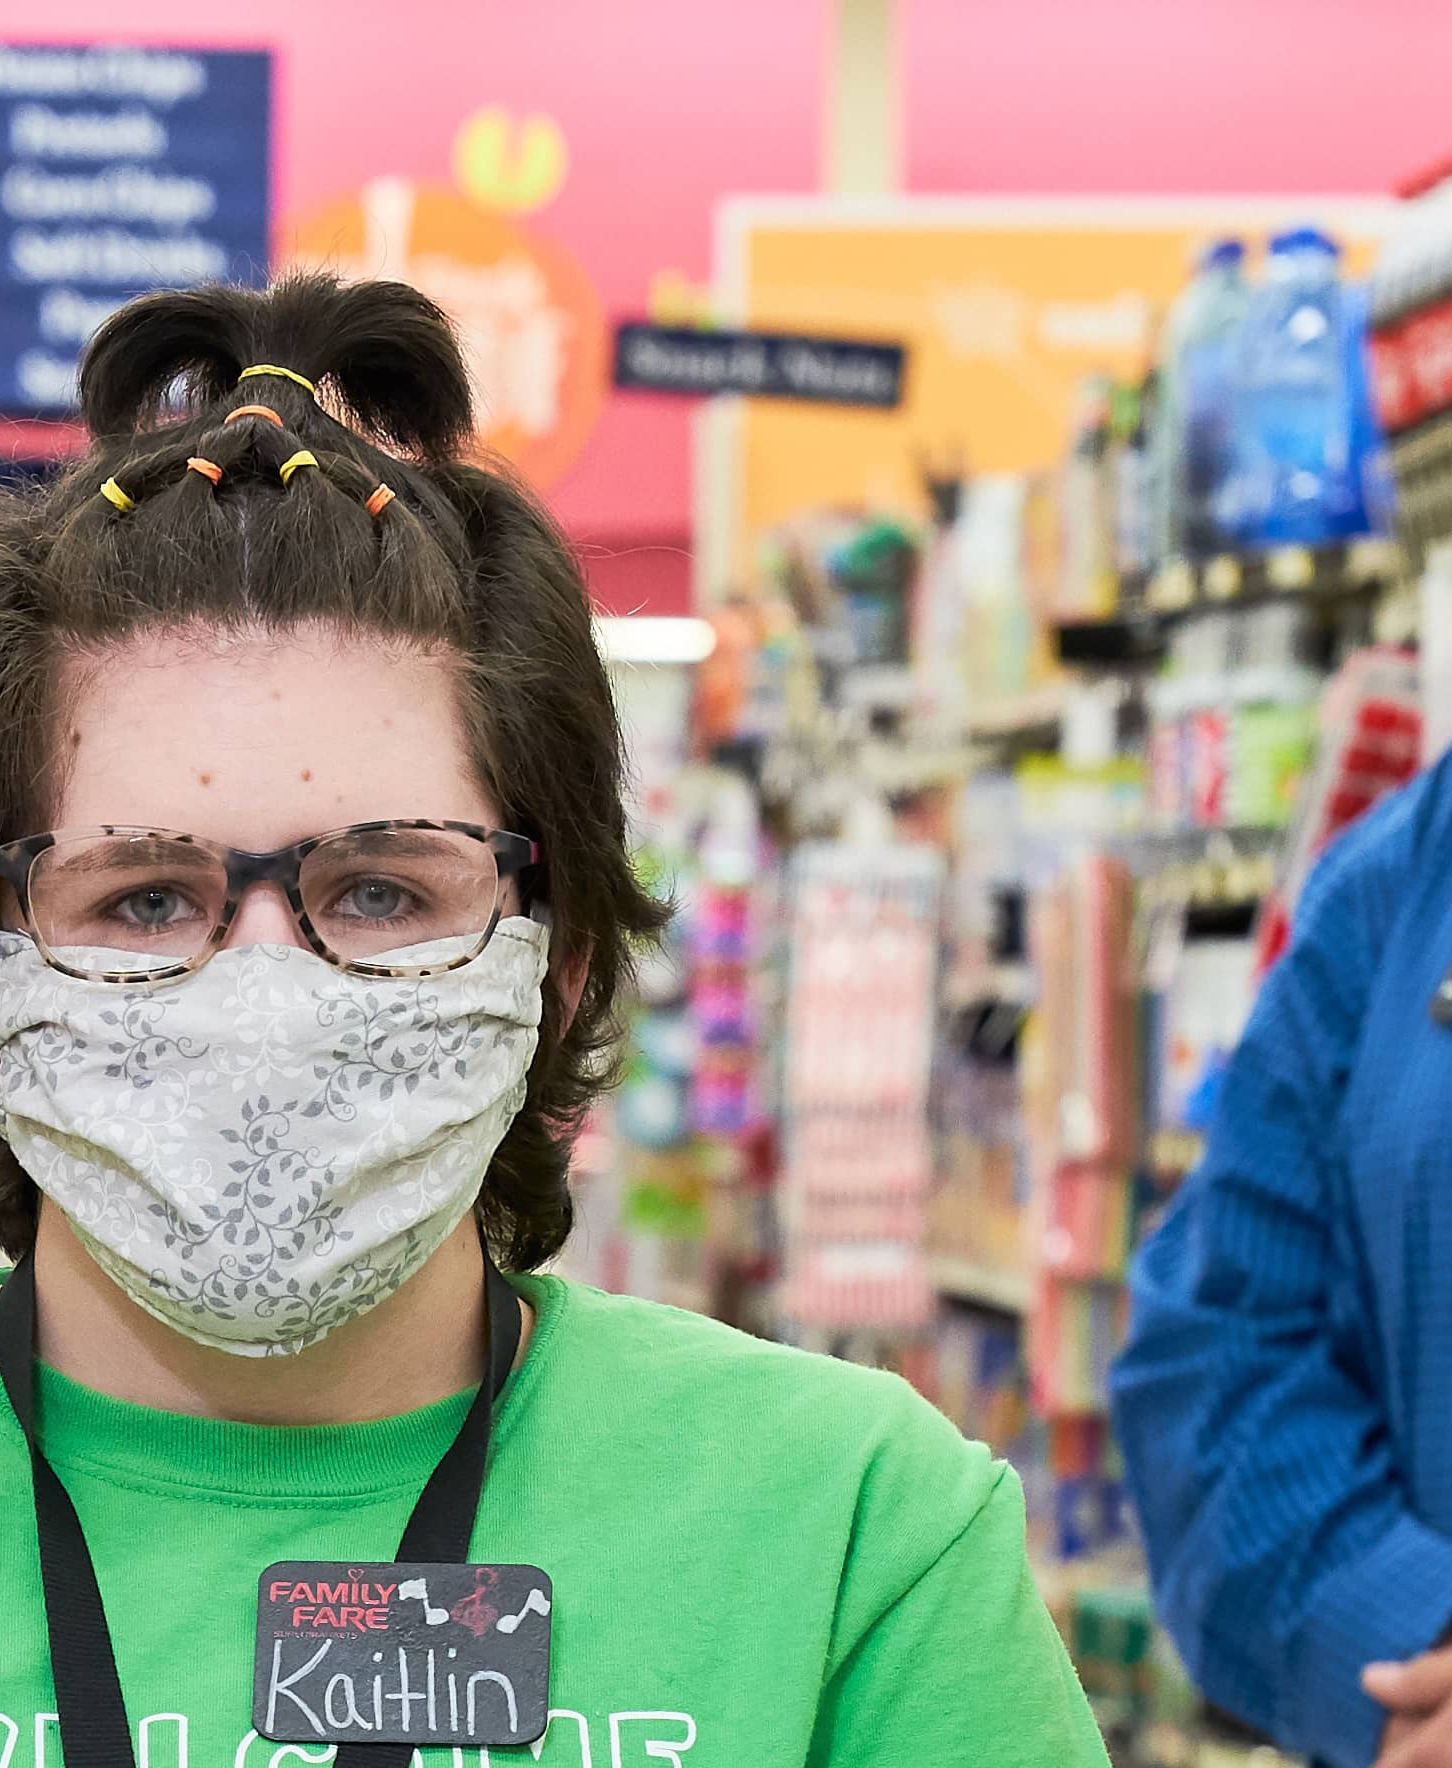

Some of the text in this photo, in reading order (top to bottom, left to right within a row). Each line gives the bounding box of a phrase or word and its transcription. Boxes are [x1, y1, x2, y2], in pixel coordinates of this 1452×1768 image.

[269, 1576, 397, 1606] FAMILY
[291, 1605, 391, 1632] FARE
[265, 1638, 518, 1737] Kaitlin
